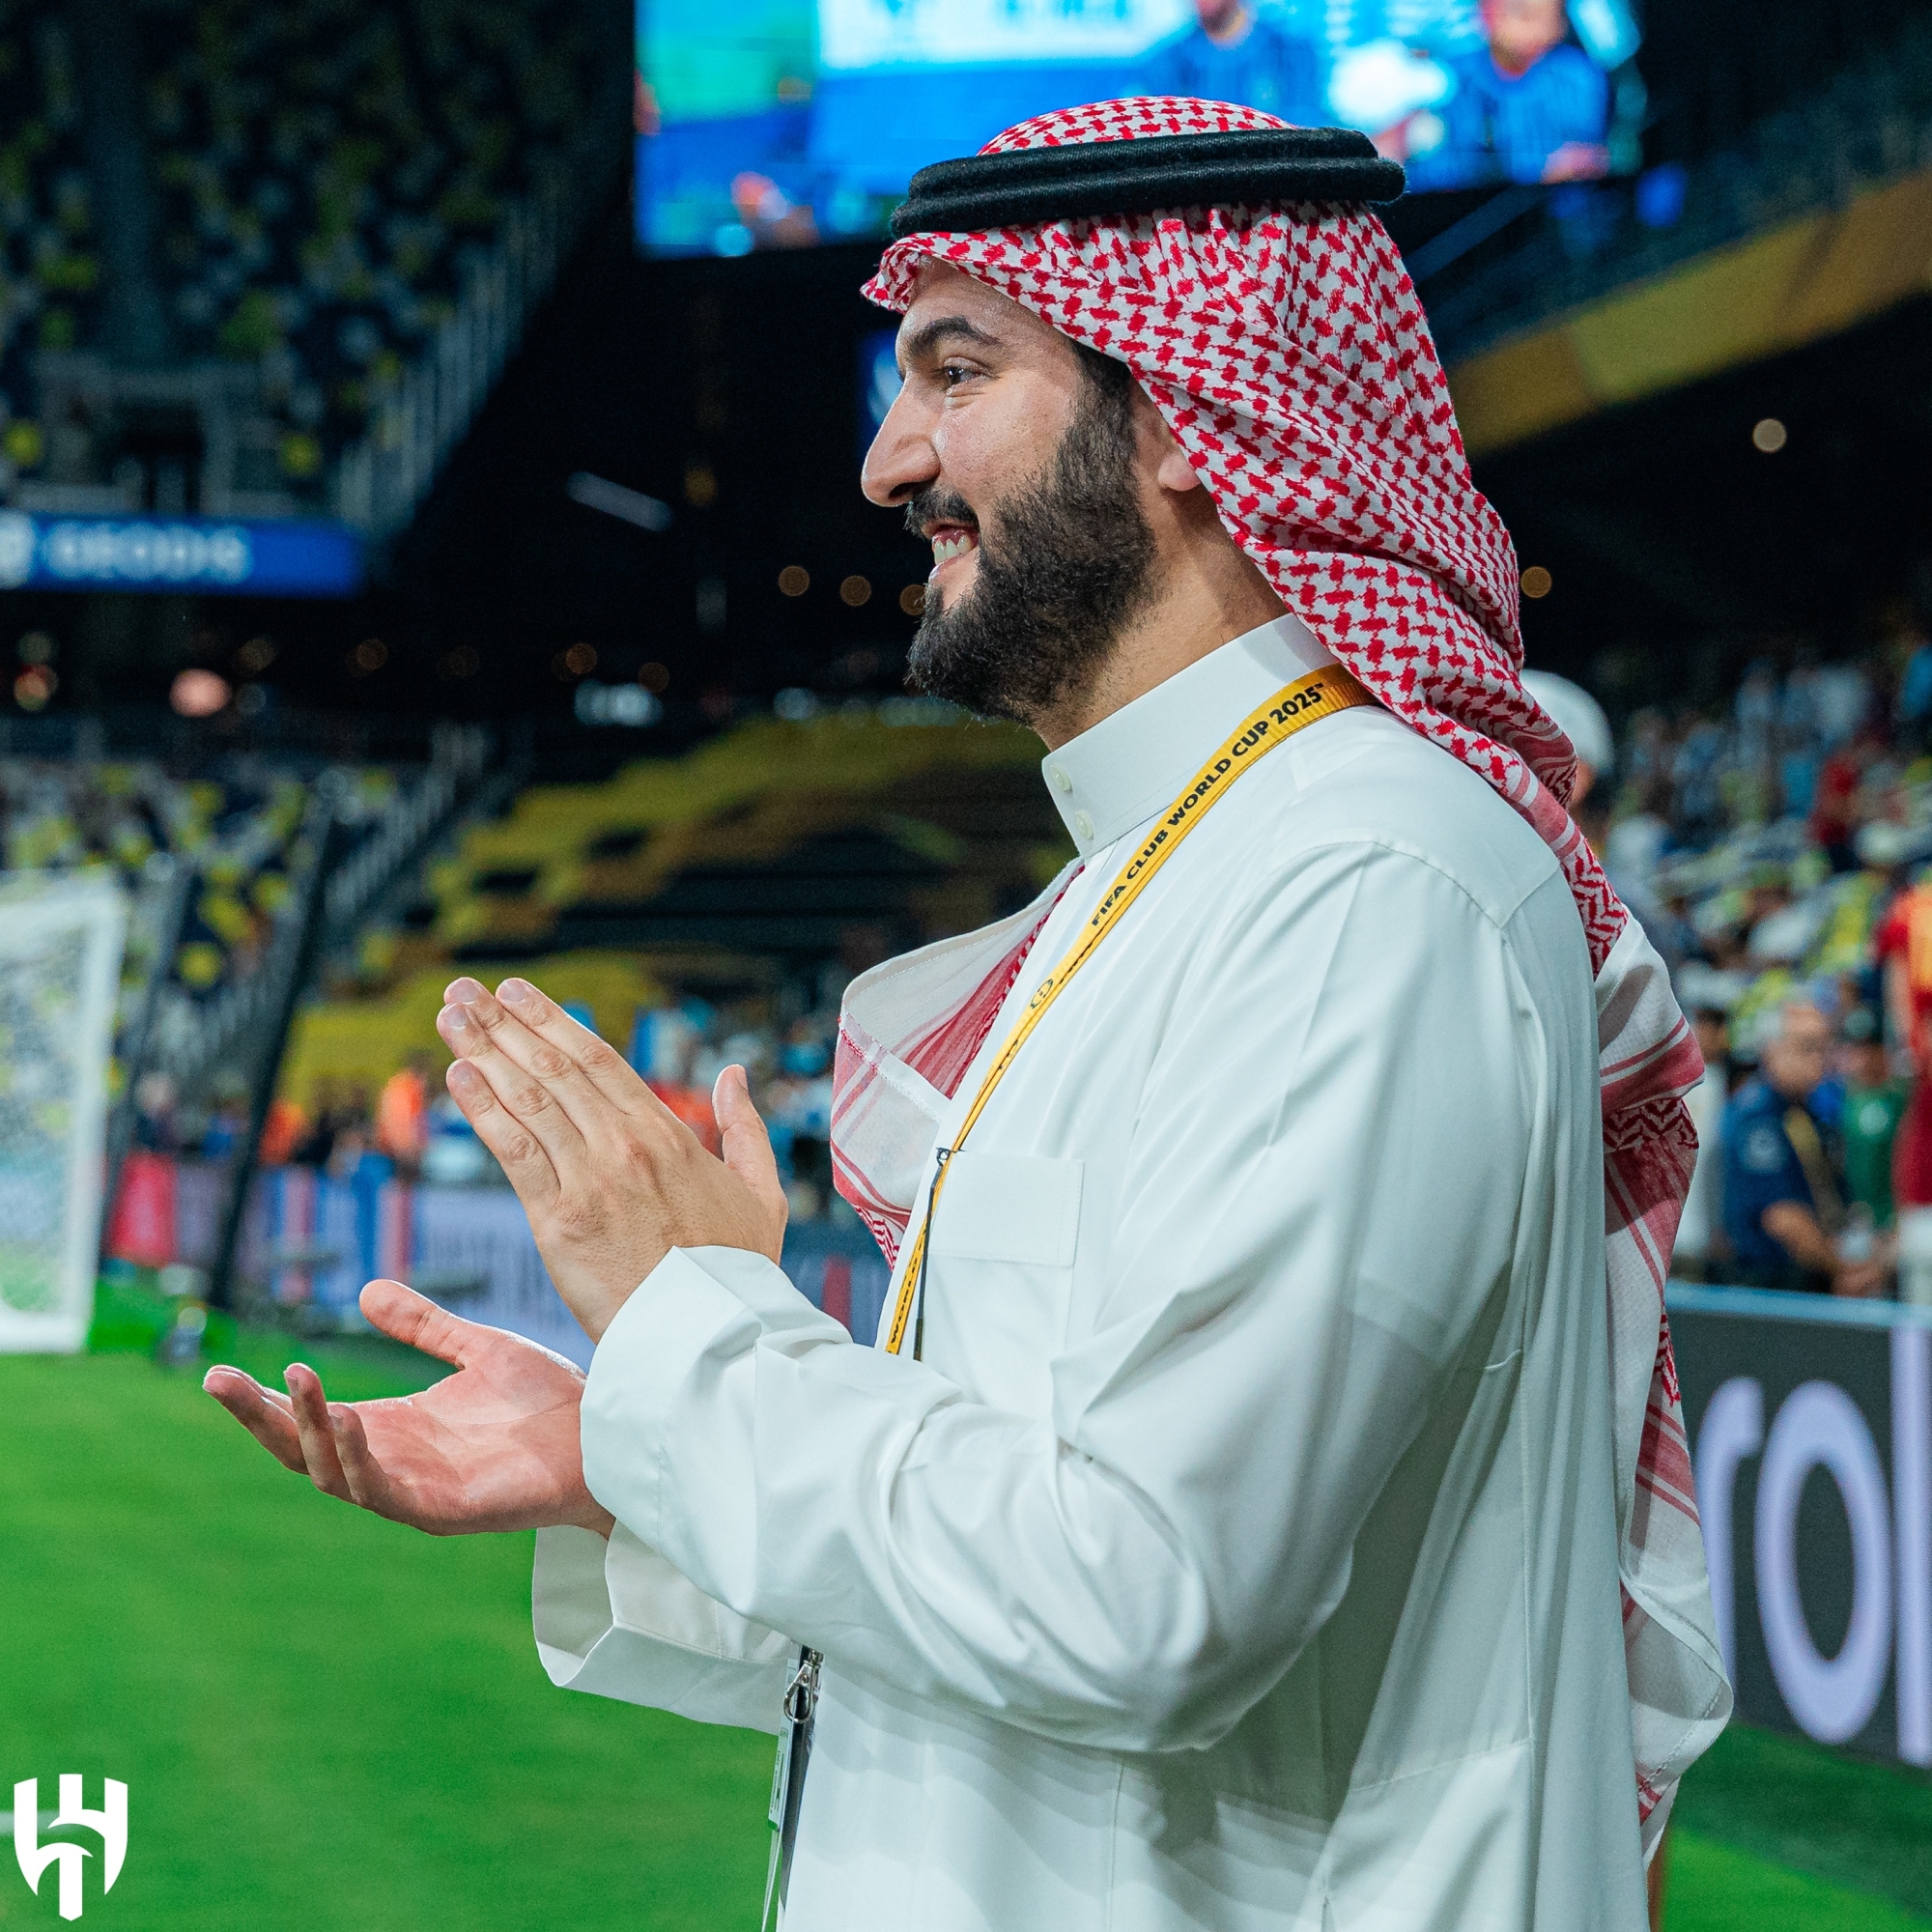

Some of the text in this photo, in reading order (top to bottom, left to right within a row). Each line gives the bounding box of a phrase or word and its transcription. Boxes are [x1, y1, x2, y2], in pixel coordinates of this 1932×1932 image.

[1092, 884, 1127, 926] FIFA
[1126, 829, 1170, 881] CLUB
[1167, 756, 1233, 827] WORLD
[1231, 720, 1270, 758] CUP
